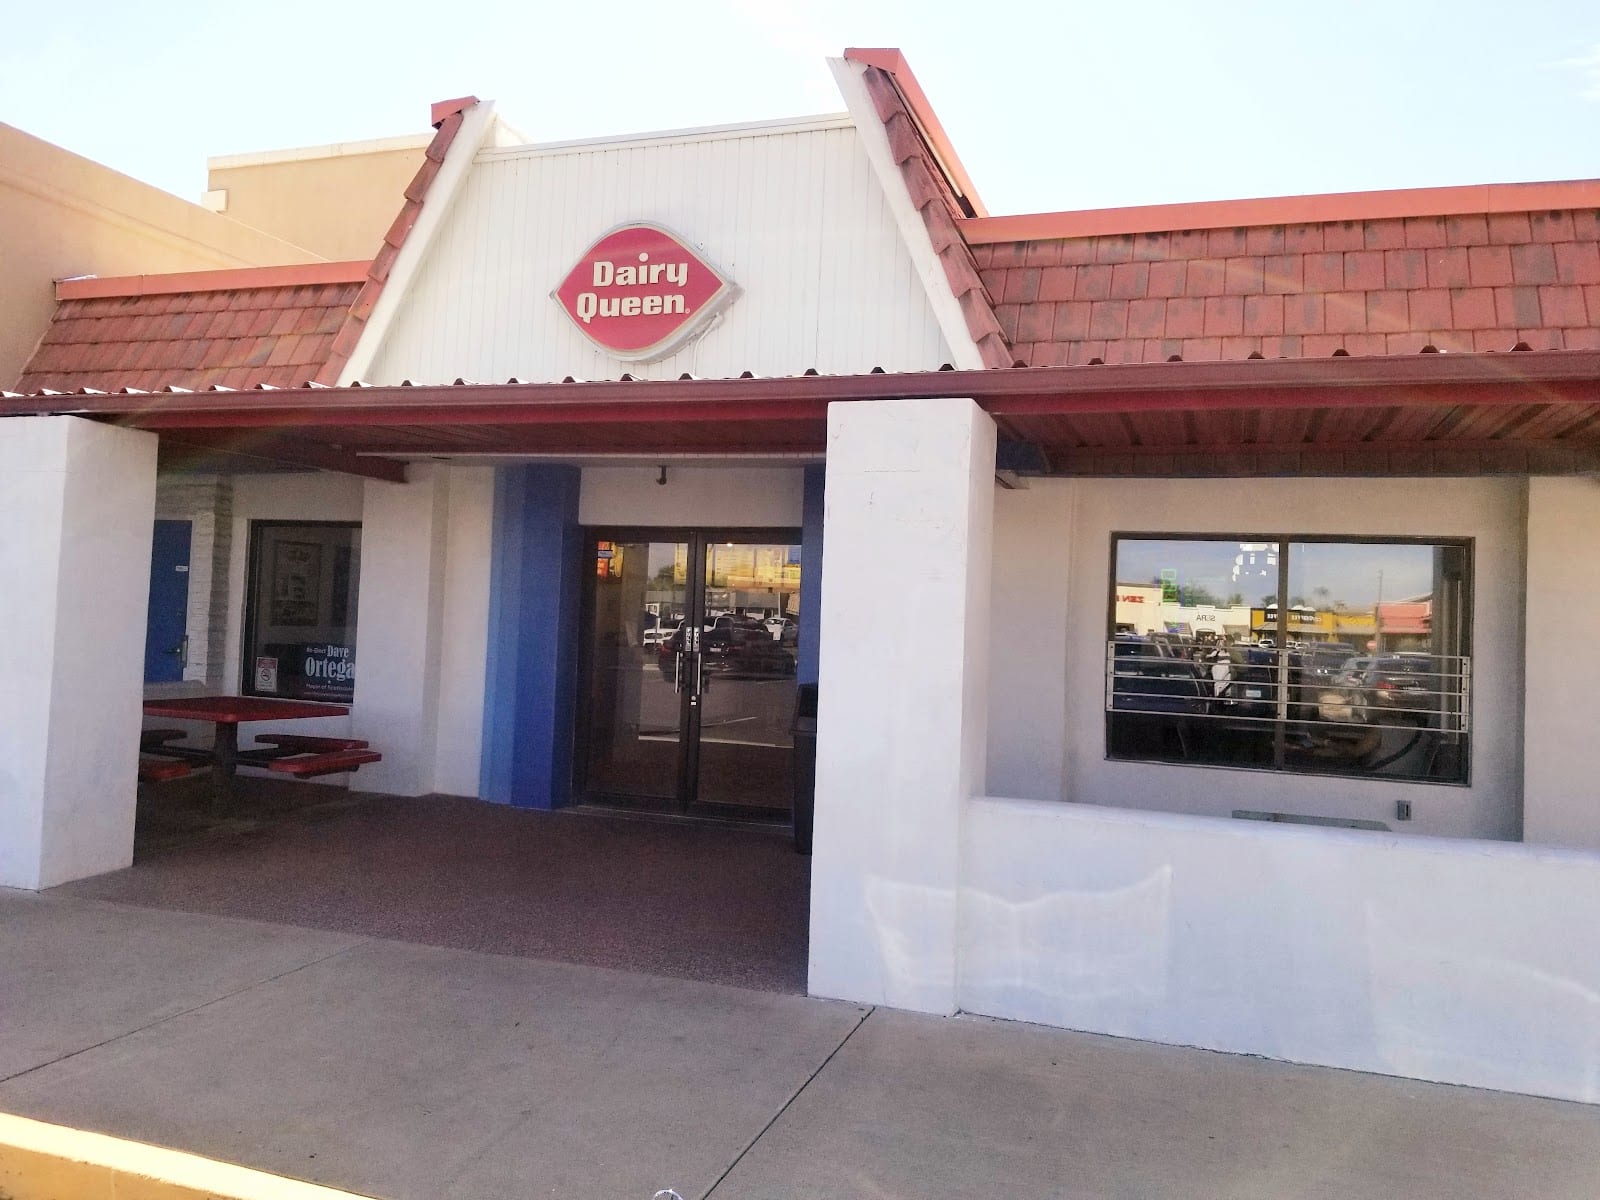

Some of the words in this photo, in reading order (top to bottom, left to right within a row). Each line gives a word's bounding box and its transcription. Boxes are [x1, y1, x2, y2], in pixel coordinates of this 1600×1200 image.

[592, 252, 688, 287] Dairy
[576, 292, 686, 324] Queen
[327, 645, 349, 658] Dave
[305, 656, 355, 682] Ortega
